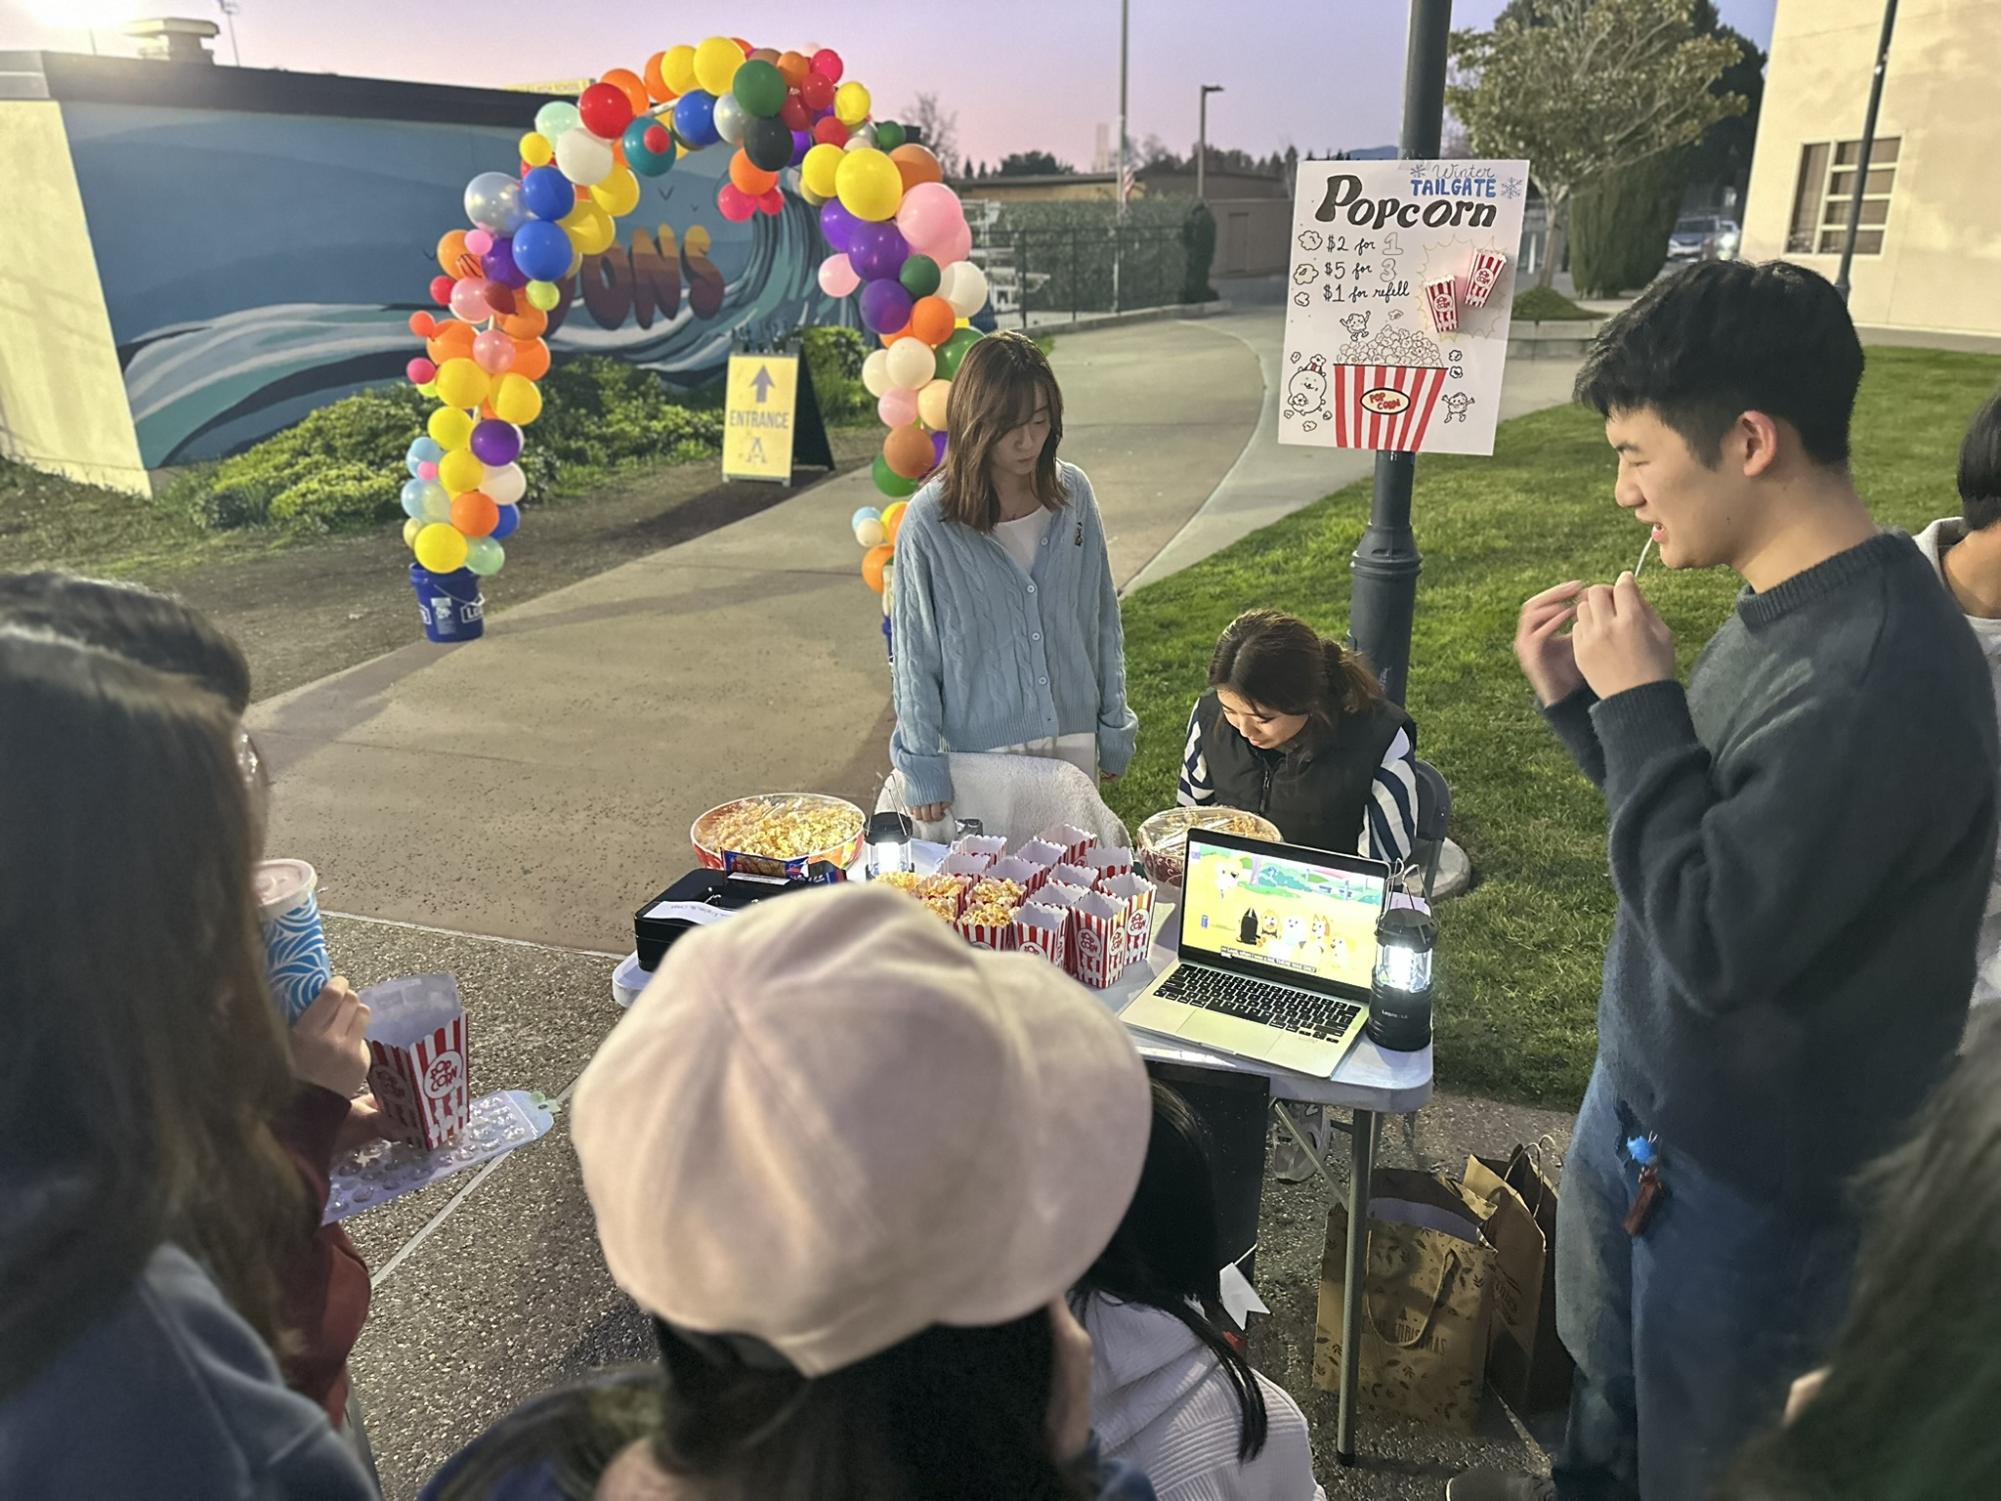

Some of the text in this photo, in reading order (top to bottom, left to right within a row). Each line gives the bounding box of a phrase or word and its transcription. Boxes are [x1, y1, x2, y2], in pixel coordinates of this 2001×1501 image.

[1432, 163, 1495, 180] Winter
[1410, 178, 1497, 198] TAILGATE
[1315, 174, 1497, 230] Popcorn
[1327, 231, 1404, 256] $2 for 1
[1324, 257, 1397, 283] $5 for 3
[1323, 280, 1410, 304] $1 for refill
[1369, 392, 1386, 404] POP
[1377, 398, 1401, 410] CORN
[730, 409, 790, 430] ENTRANCE
[746, 436, 767, 464] A
[430, 1060, 452, 1080] POP
[431, 1065, 458, 1092] CORN
